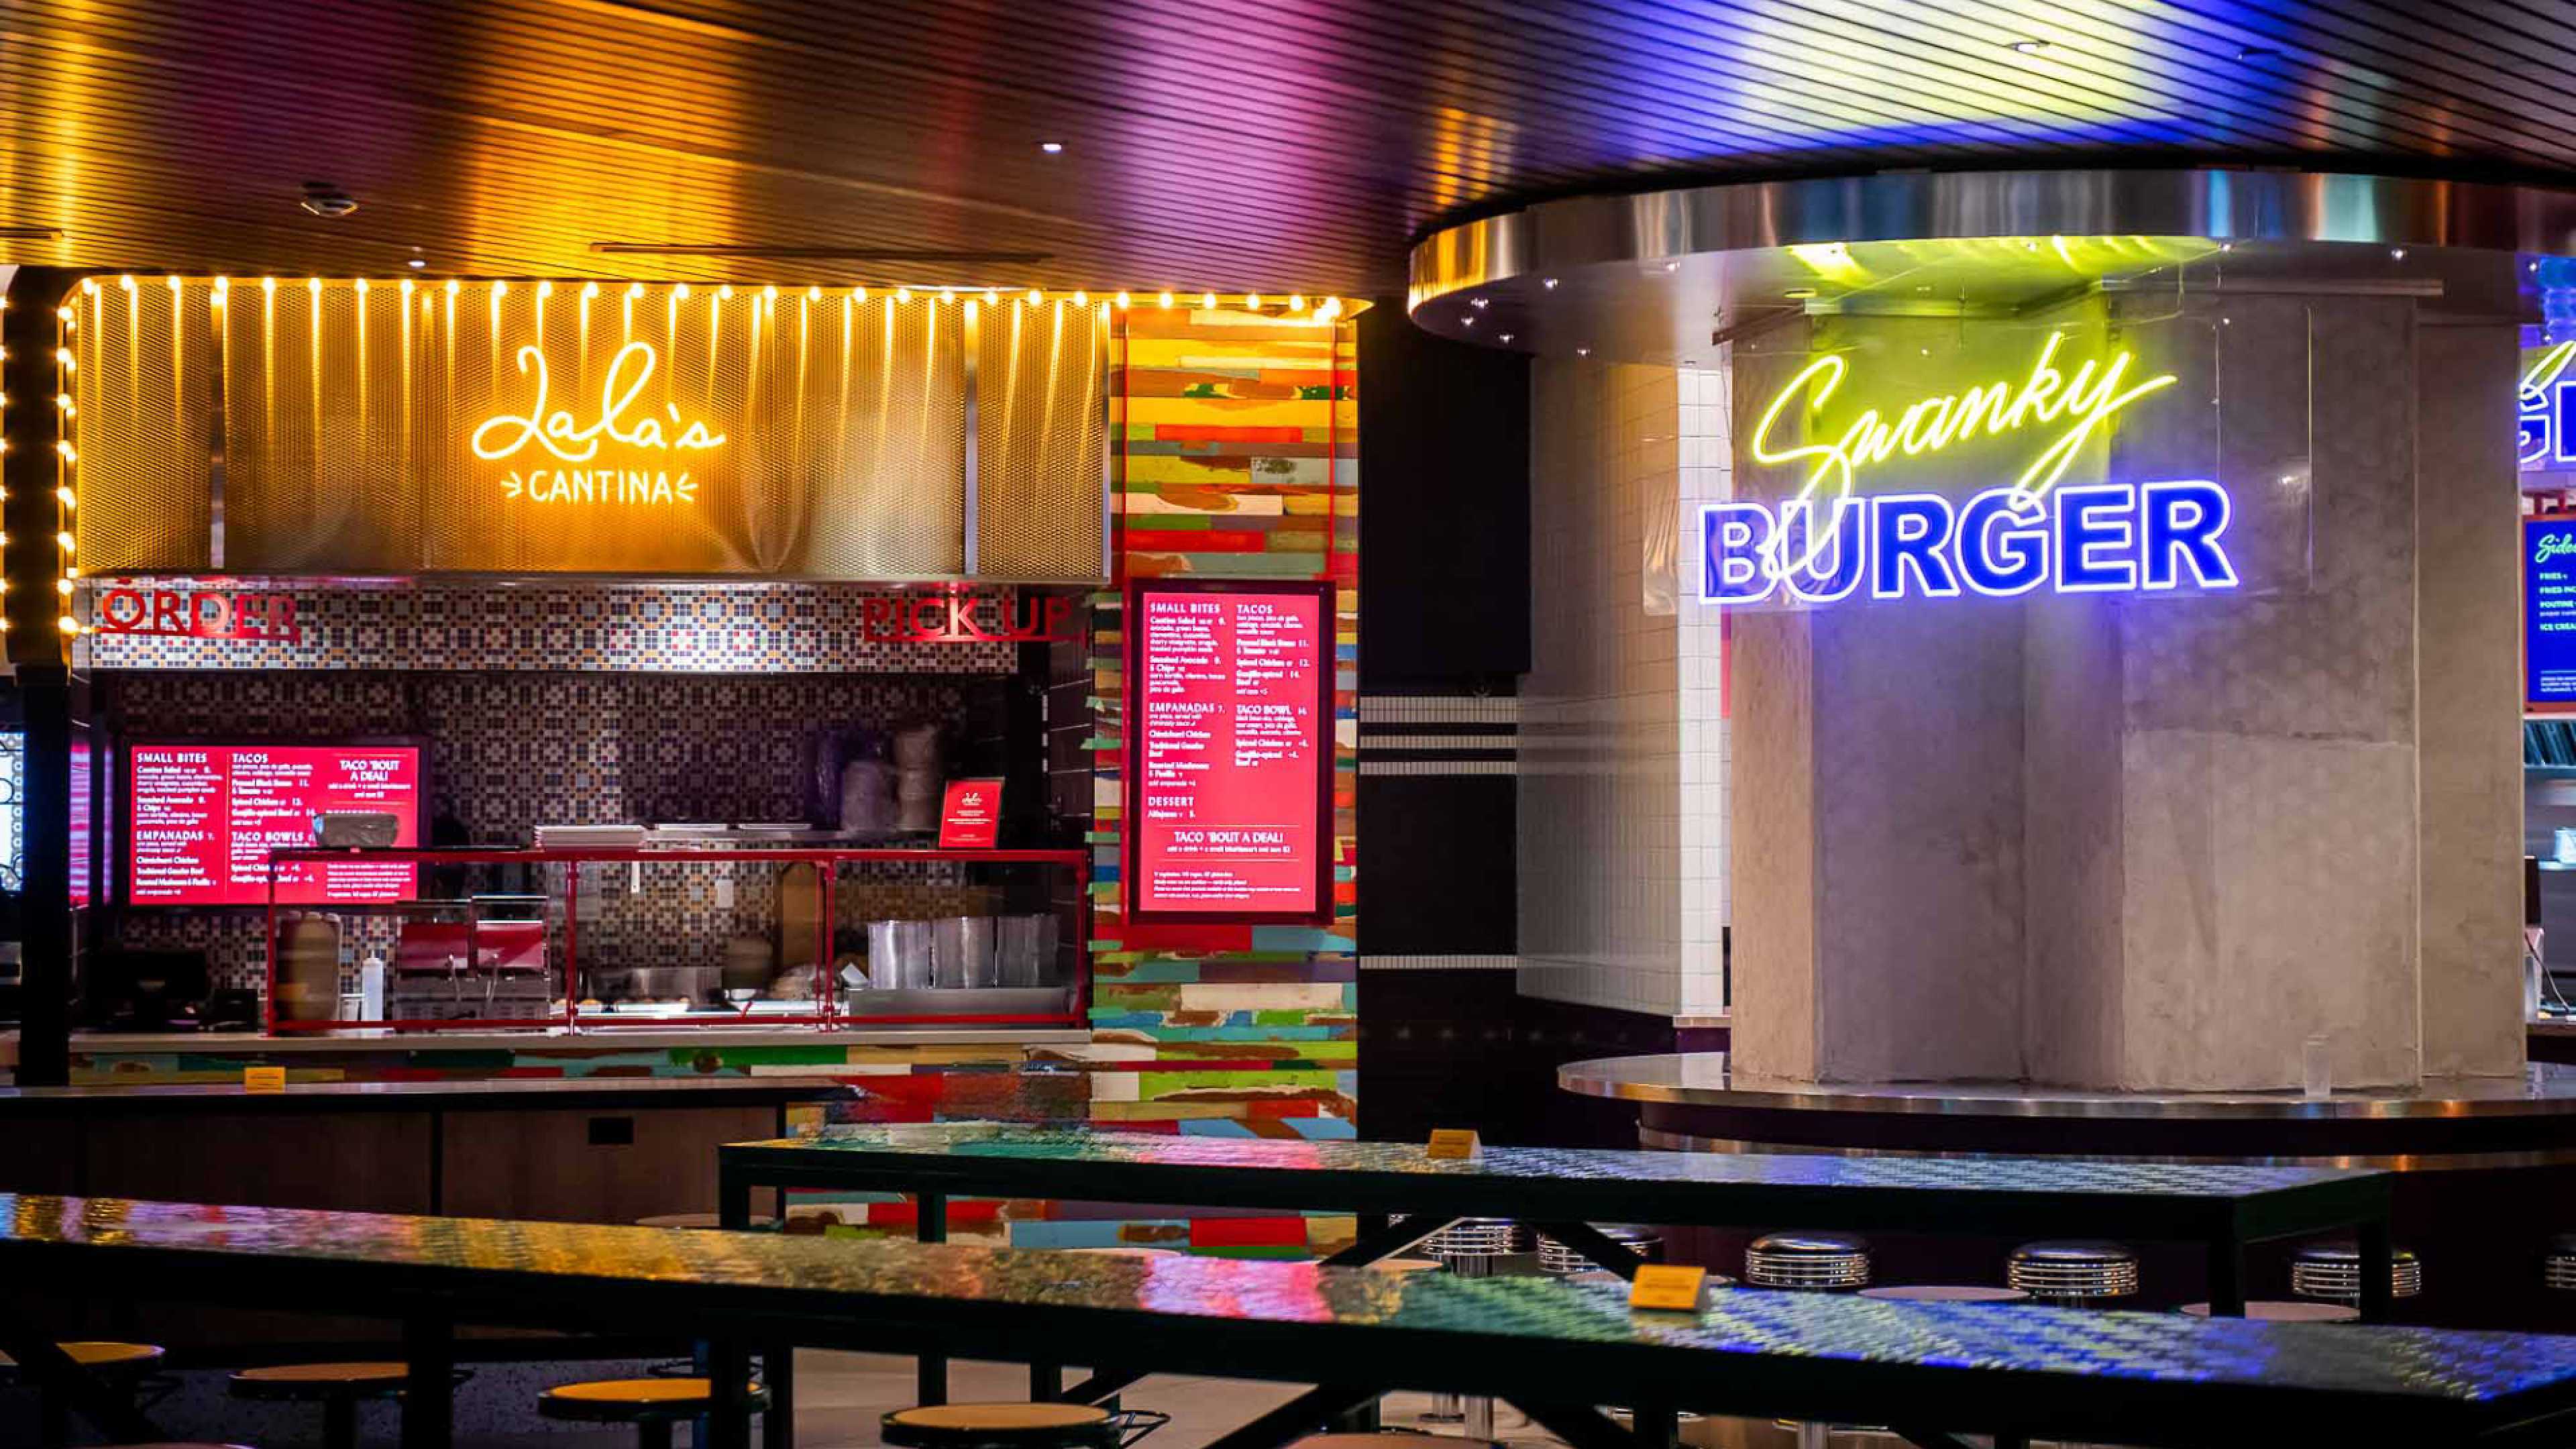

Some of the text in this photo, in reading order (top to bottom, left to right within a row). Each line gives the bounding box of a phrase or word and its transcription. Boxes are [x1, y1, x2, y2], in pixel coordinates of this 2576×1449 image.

[472, 341, 727, 463] Lala's
[1752, 331, 2178, 581] Swanky
[527, 470, 674, 504] CANTINA
[1699, 480, 2241, 605] BURGER
[1150, 603, 1220, 614] SMALL BITES
[1236, 604, 1273, 614] TACOS
[102, 588, 301, 641] ORDER
[863, 595, 1073, 642] PICK UP
[1149, 703, 1215, 713] EMPANADAS
[1236, 704, 1261, 714] TACO
[137, 753, 207, 763] SMALL BITES
[232, 753, 268, 763] TACOS
[339, 759, 368, 771] TACO
[350, 771, 359, 781] A
[1148, 796, 1194, 806] DESSERT
[136, 831, 204, 841] EMPANADAS
[231, 831, 304, 842] TACO BOWLS
[1174, 831, 1203, 843] TACO
[1242, 832, 1250, 843] A
